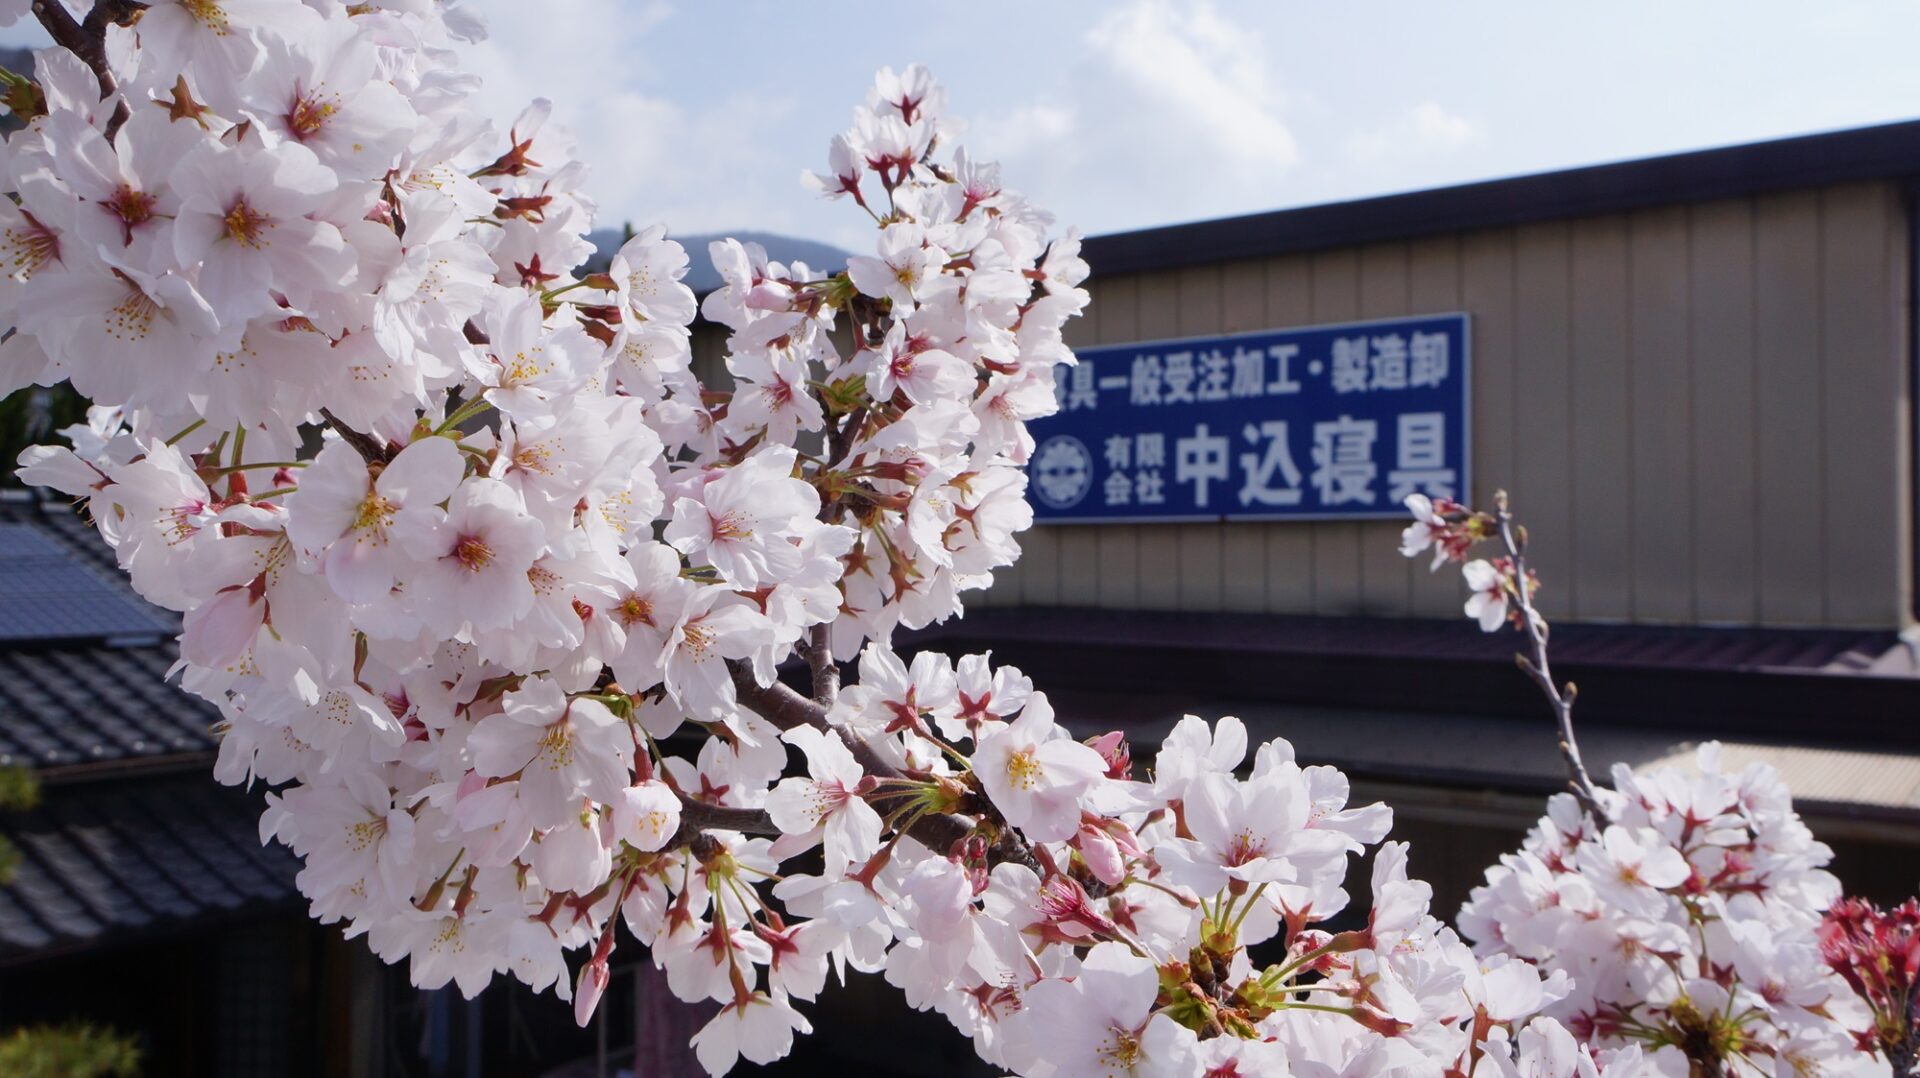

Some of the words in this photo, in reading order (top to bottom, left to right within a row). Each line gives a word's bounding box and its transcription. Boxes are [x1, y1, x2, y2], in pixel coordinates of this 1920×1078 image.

[1104, 433, 1164, 469] 有限
[1176, 412, 1456, 507] 中込寝具
[1104, 469, 1165, 506] 会社
